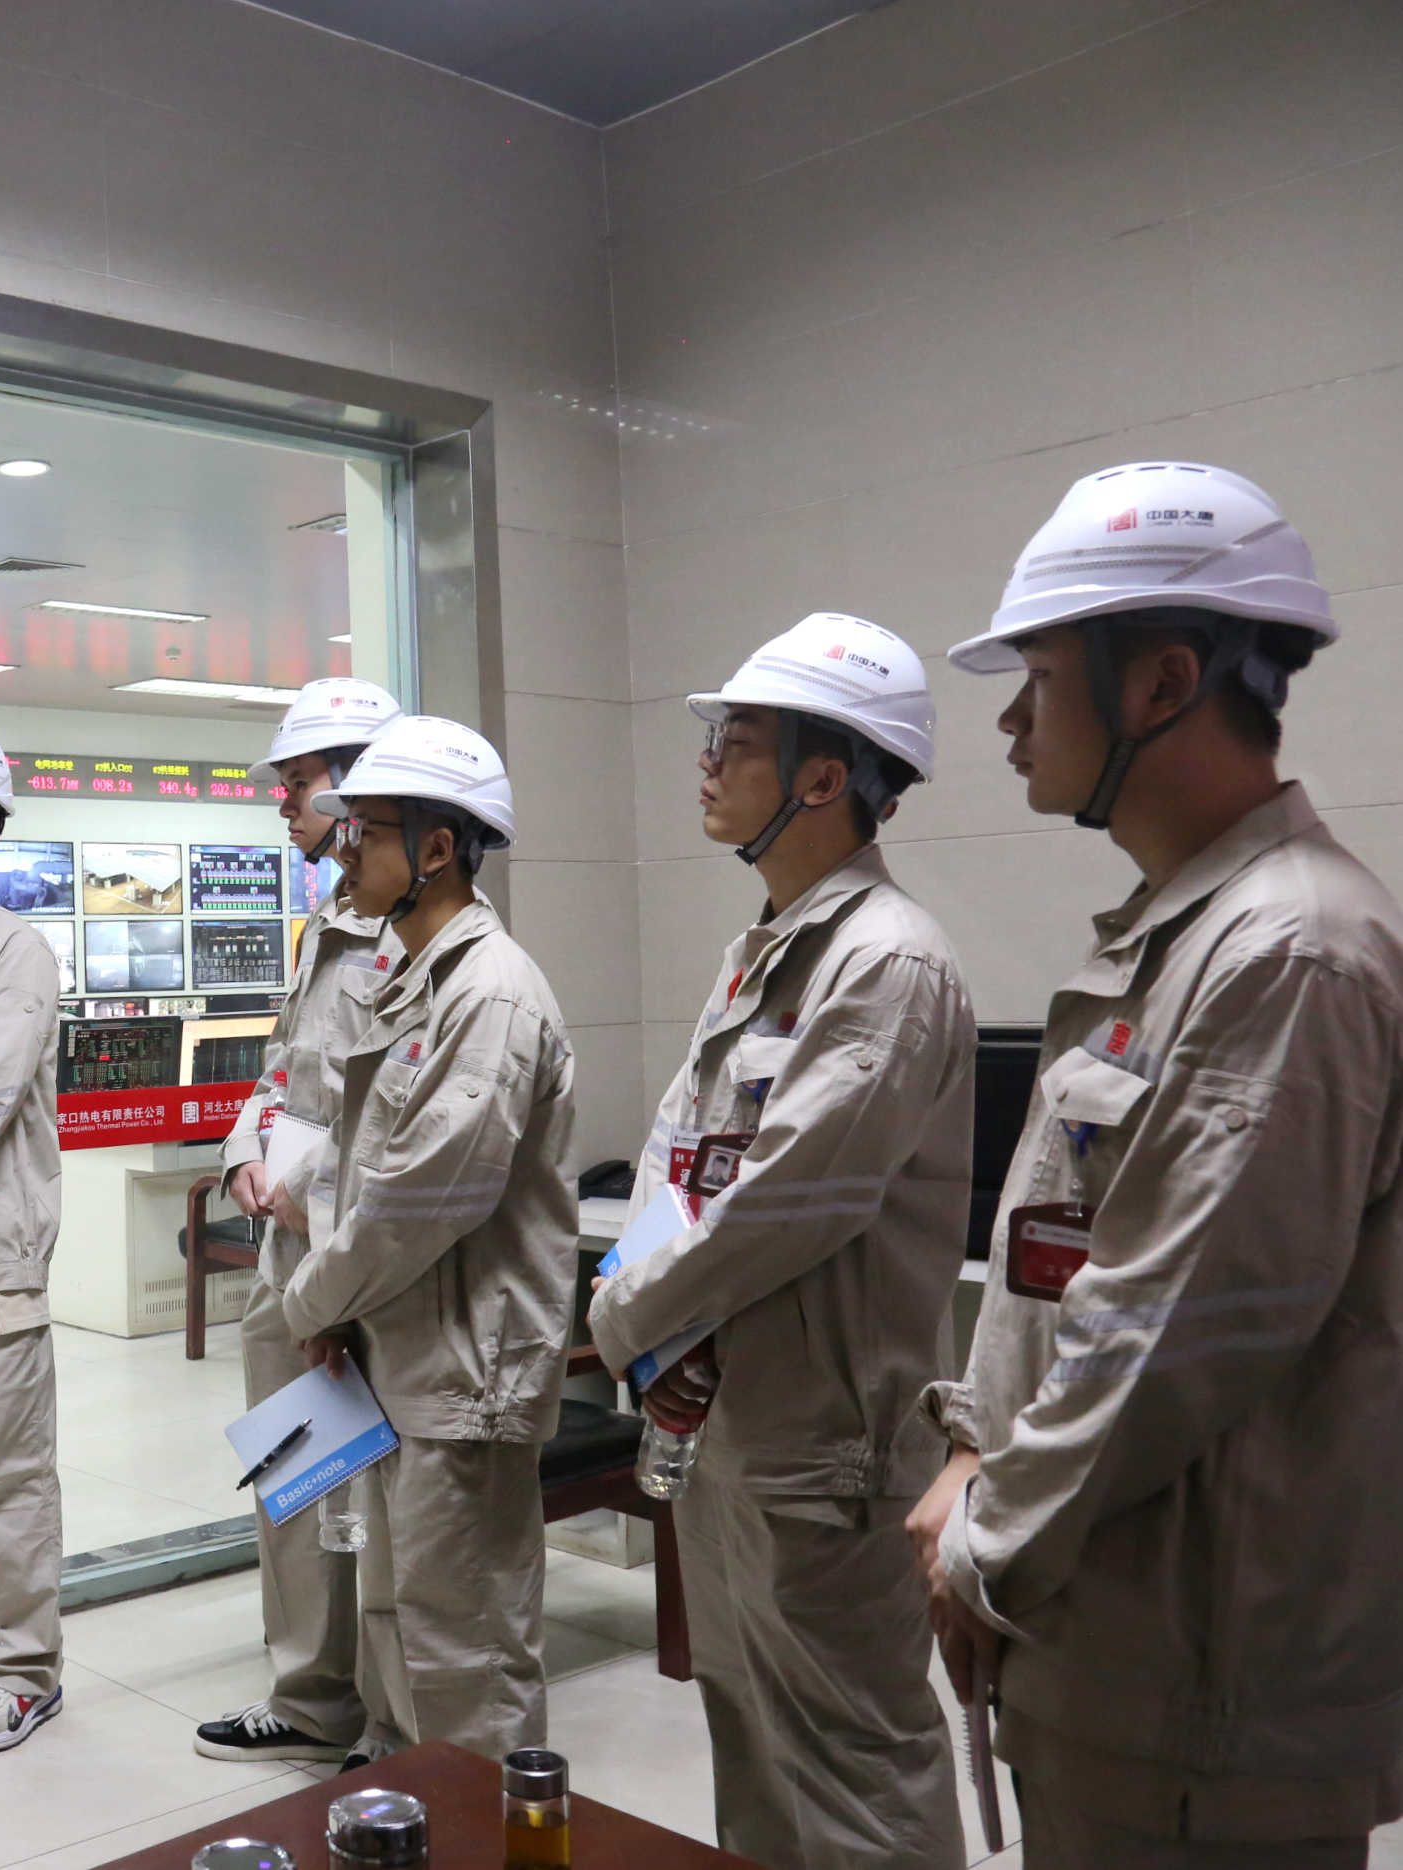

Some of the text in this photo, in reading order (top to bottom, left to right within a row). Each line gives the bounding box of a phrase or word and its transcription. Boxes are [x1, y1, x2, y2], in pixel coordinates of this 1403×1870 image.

[1146, 509, 1214, 521] 中国大唐
[847, 653, 890, 676] 中国大唐
[445, 746, 479, 763] 中国大唐
[203, 1099, 247, 1114] 河北大唐
[57, 1105, 165, 1126] 家口热电有限责任公司
[203, 1114, 220, 1122] Hebei
[59, 1123, 96, 1134] Zhangjiakou
[97, 1122, 121, 1131] Thermal
[153, 1118, 165, 1126] Ltd.
[275, 1457, 347, 1509] Basic+note
